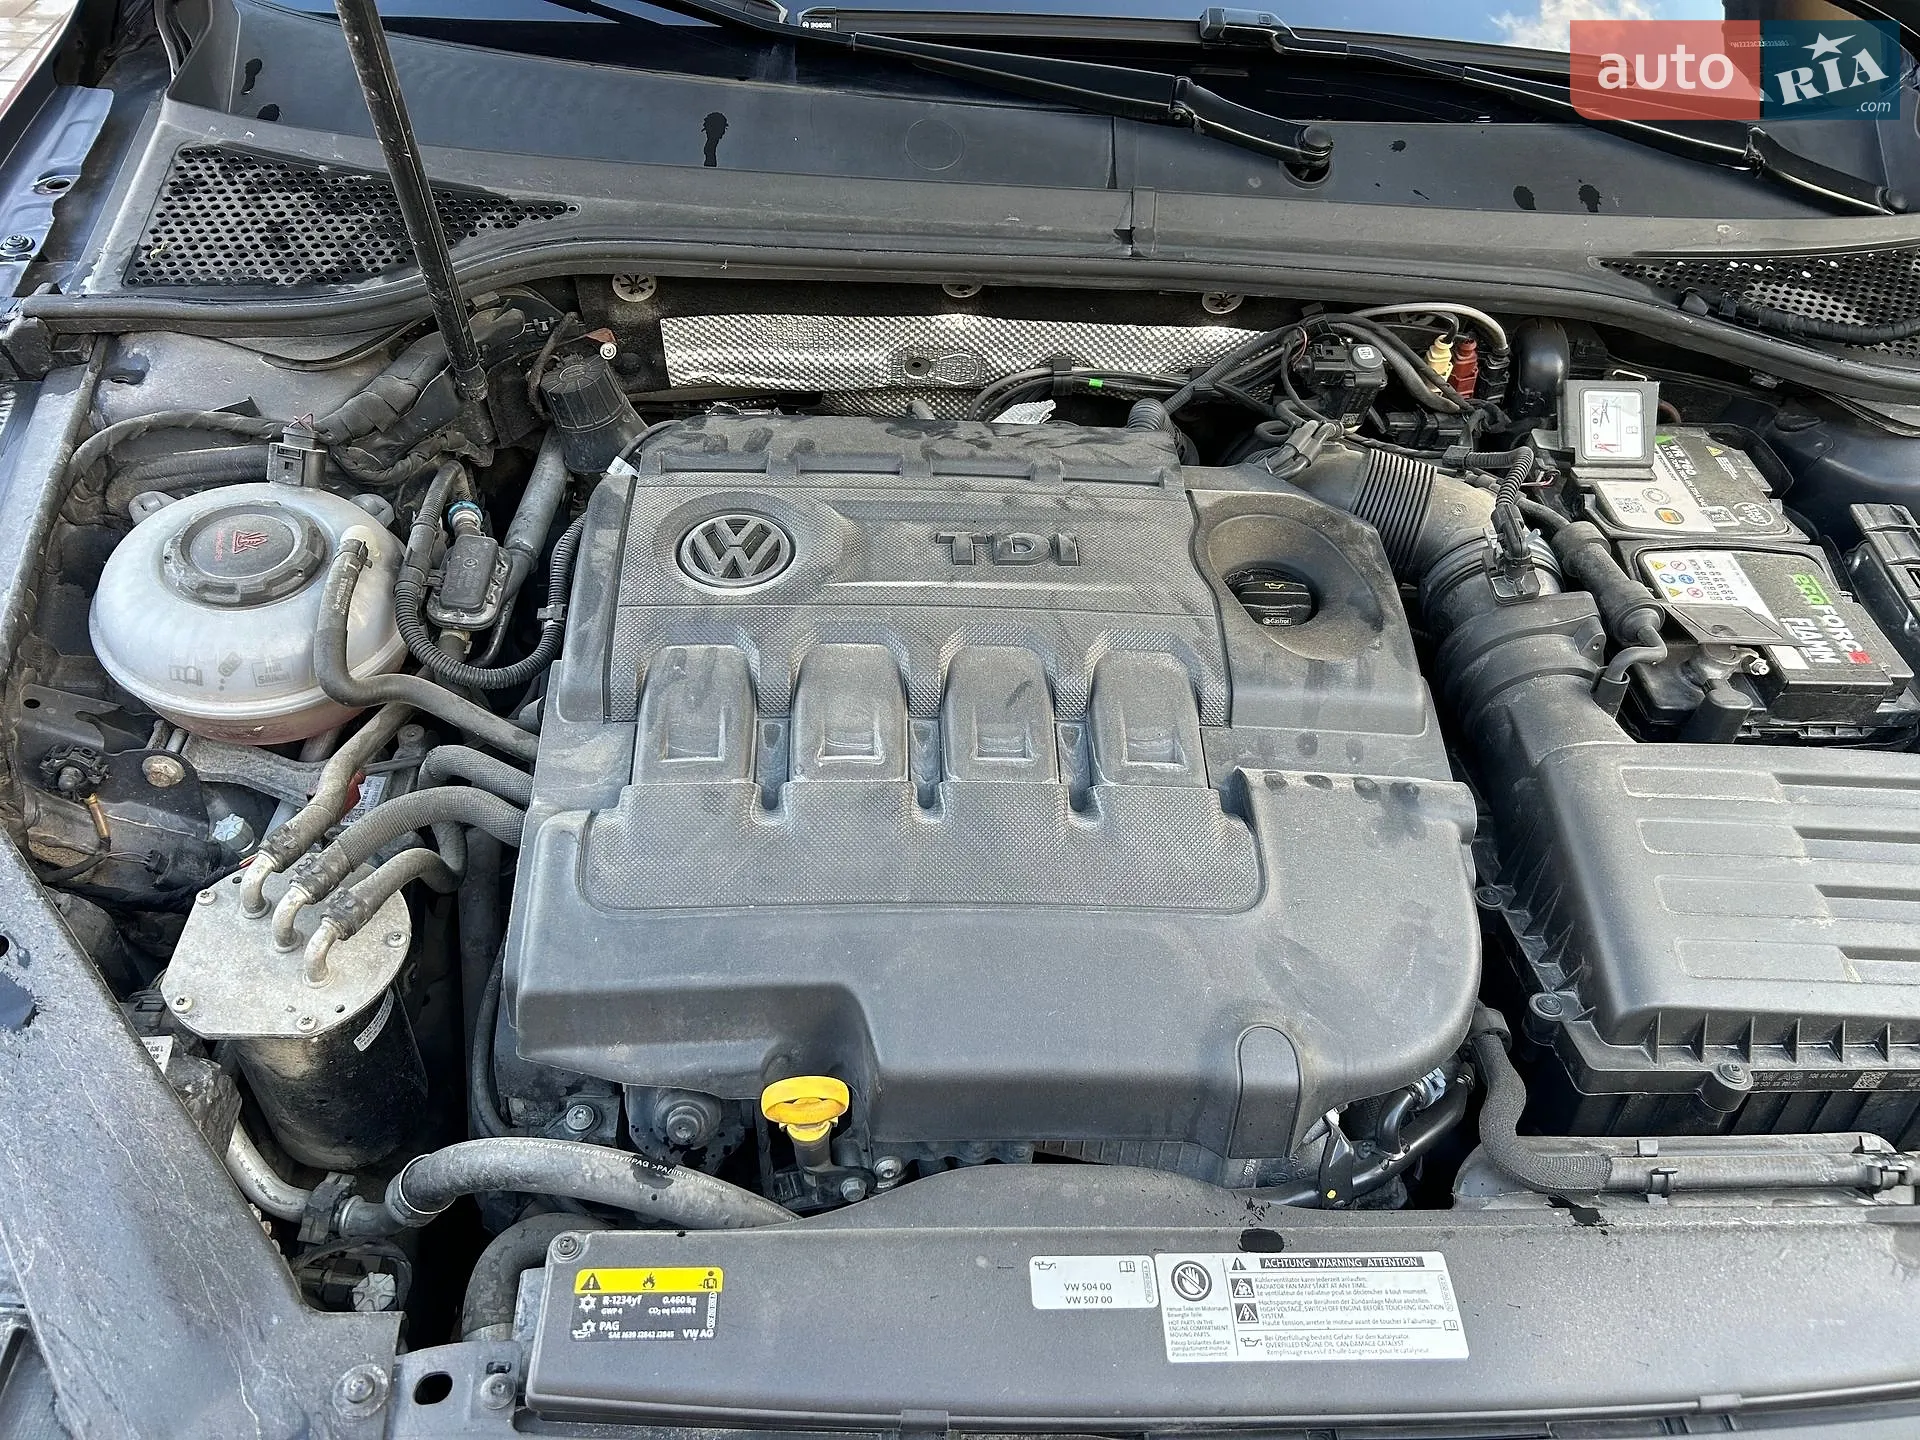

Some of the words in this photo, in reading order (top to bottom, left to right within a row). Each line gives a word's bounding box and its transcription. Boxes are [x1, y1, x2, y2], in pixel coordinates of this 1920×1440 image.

[1681, 459, 1697, 475] 760
[935, 531, 1081, 567] TDI
[1782, 617, 1842, 663] FIAMM
[1264, 1258, 1311, 1268] ACHTUNG
[1316, 1258, 1362, 1267] WARNING
[1367, 1257, 1418, 1267] ATTENTION
[1064, 1283, 1080, 1291] VW
[1081, 1282, 1098, 1290] 504
[1099, 1282, 1112, 1290] 00
[602, 1295, 643, 1307] R-1234yf
[686, 1295, 698, 1306] kg
[1065, 1296, 1081, 1304] VW
[1083, 1296, 1099, 1304] 507
[1101, 1296, 1113, 1304] 00
[601, 1307, 619, 1315] GWP
[600, 1320, 620, 1331] PAG
[608, 1331, 621, 1339] SAE
[682, 1328, 700, 1339] VW
[699, 1328, 715, 1338] AG
